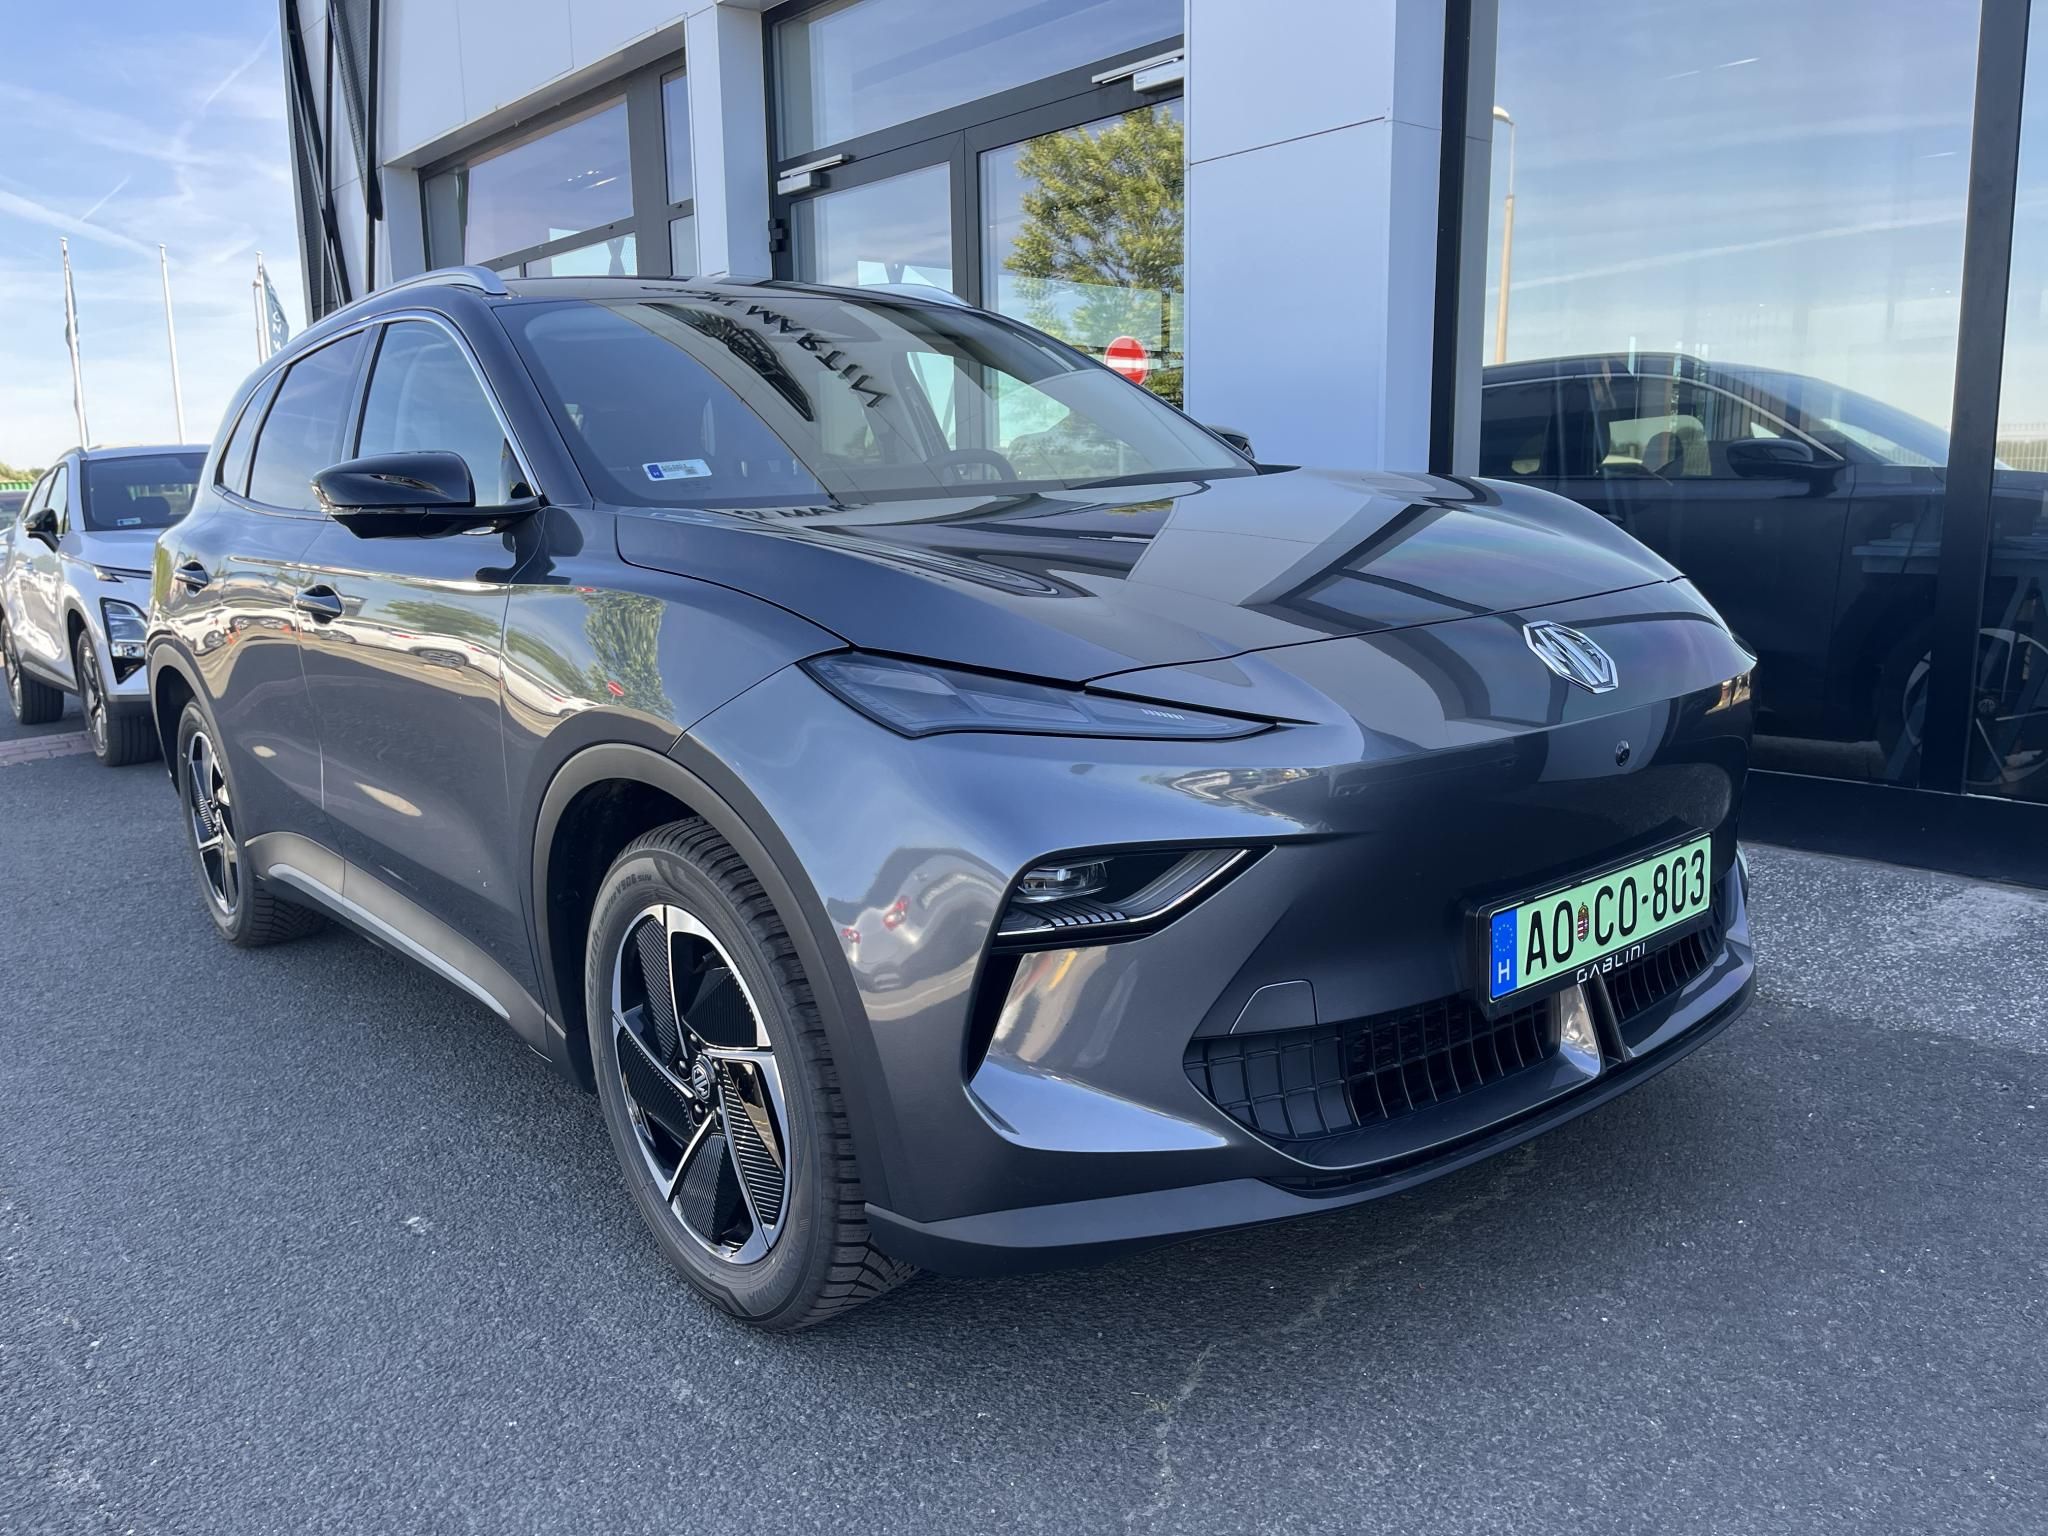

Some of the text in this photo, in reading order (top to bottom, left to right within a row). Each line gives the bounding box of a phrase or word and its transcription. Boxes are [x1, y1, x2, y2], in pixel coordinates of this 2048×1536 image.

[1532, 623, 1613, 689] MG
[1498, 958, 1511, 984] H
[1576, 942, 1646, 984] GABLINI
